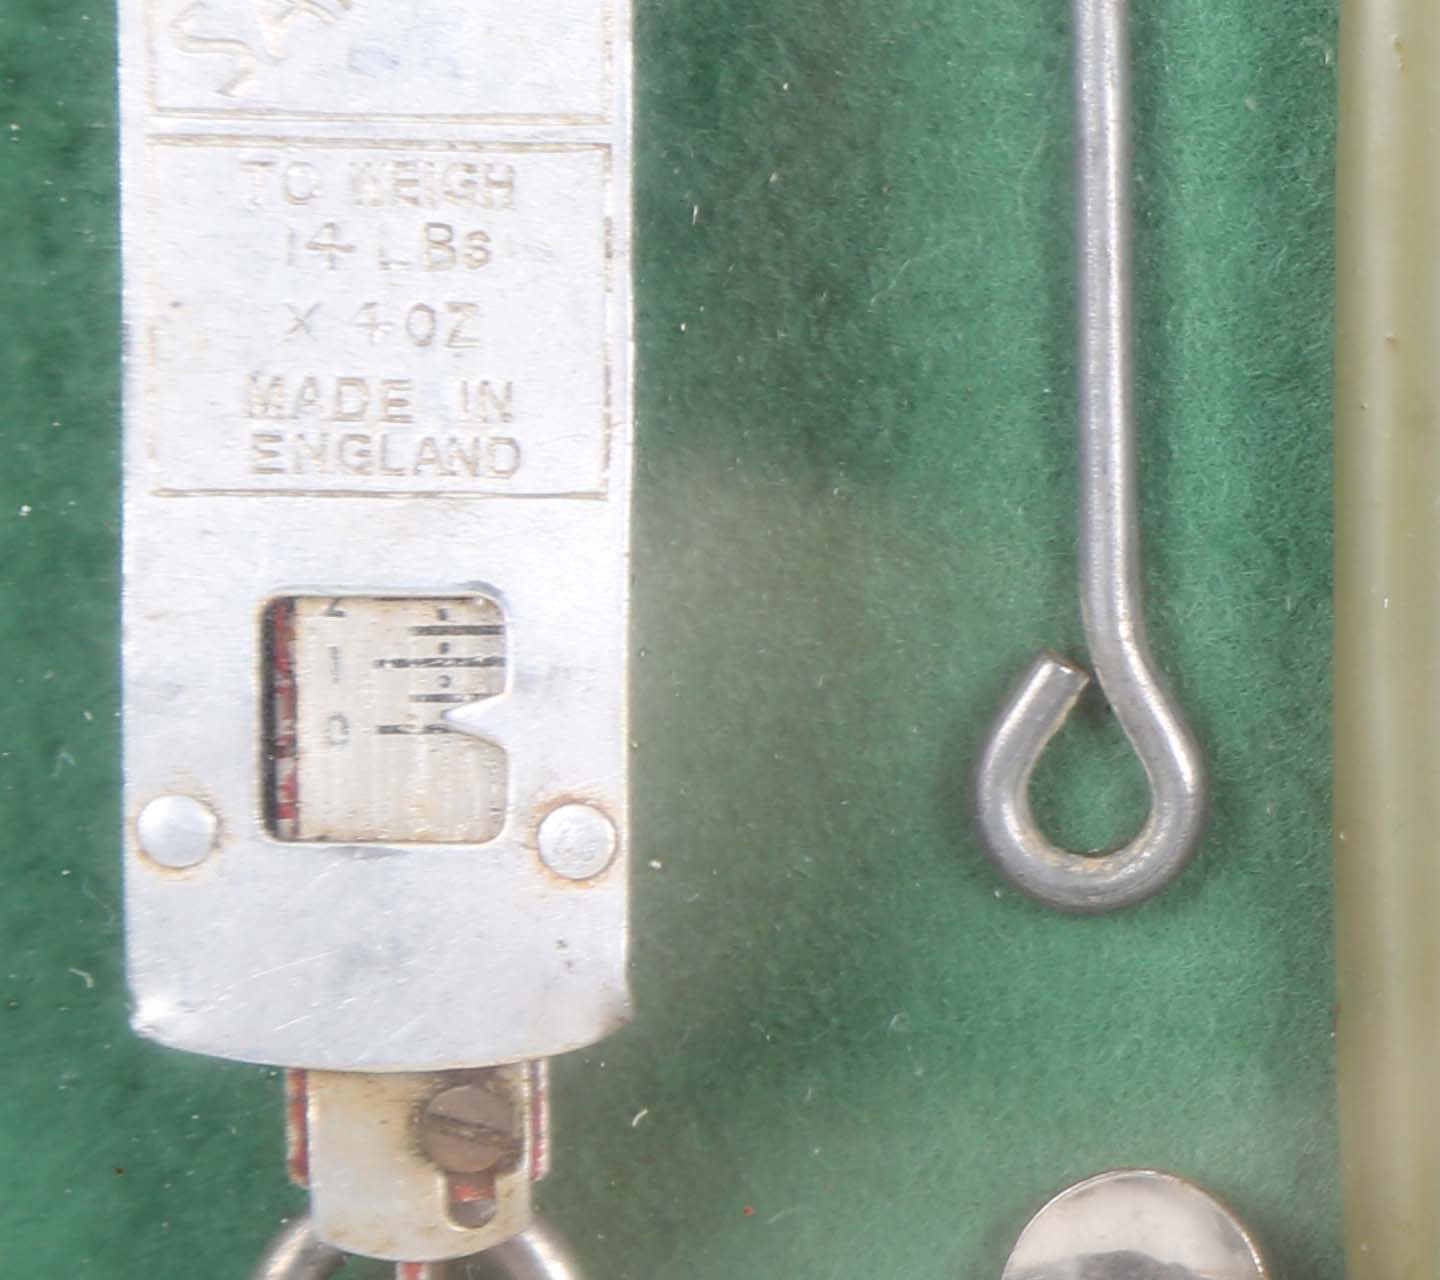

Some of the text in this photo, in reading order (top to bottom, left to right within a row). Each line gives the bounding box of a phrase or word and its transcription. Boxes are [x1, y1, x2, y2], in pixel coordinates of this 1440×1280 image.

[239, 158, 517, 210] TO WEIGH
[244, 370, 514, 424] MADE IN
[249, 432, 523, 480] ENGLAND
